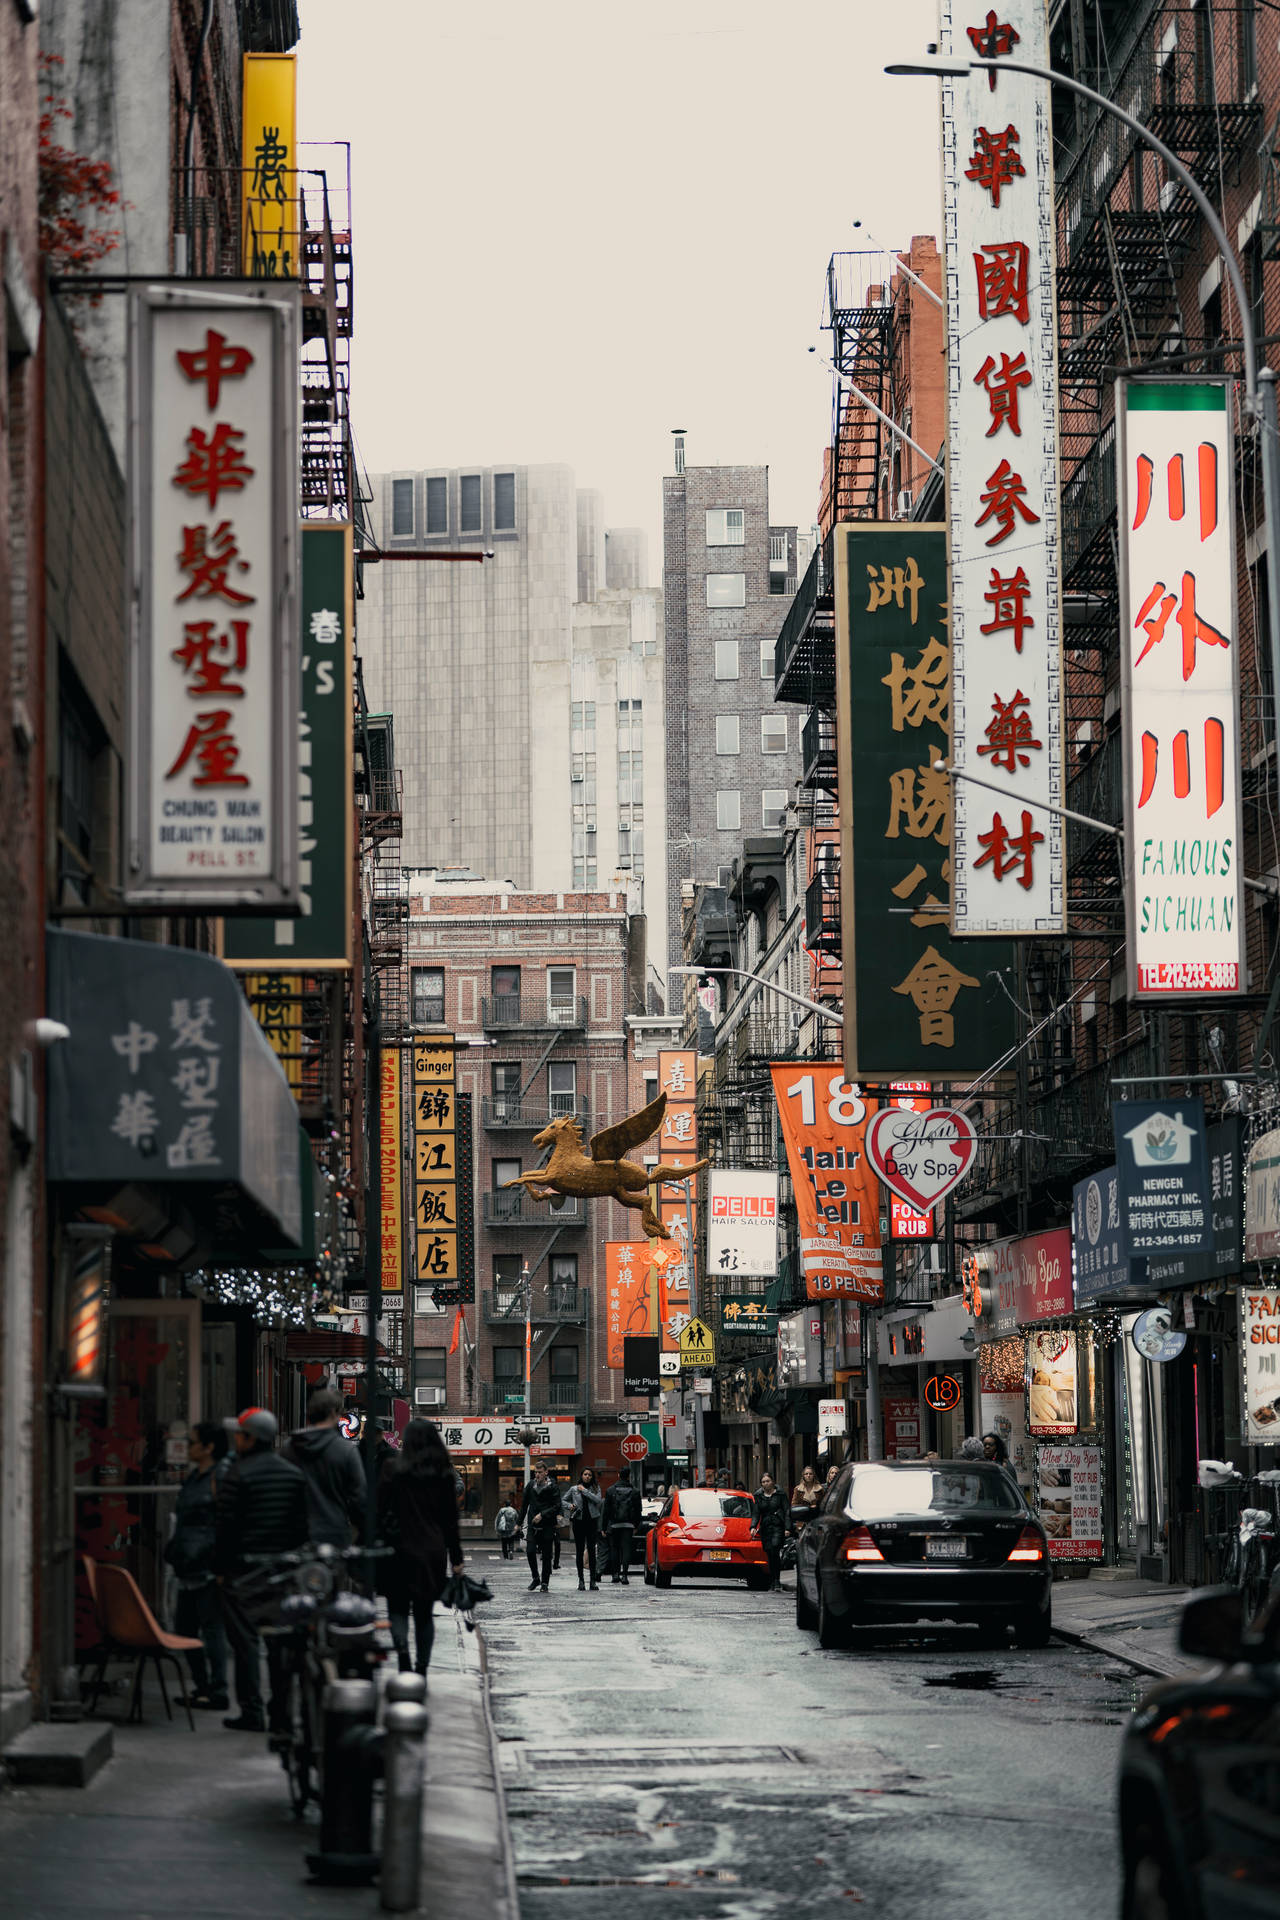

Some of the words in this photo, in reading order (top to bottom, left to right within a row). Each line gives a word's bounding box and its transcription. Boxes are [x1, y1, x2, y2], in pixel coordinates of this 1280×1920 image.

[166, 328, 256, 788] 中華髮型屋
[1132, 441, 1232, 820] 川外川
[162, 801, 217, 818] CHUNG
[226, 801, 261, 818] WAH
[159, 825, 214, 844] BEAUTY
[221, 826, 265, 844] SALON
[186, 850, 227, 867] PELL
[1141, 838, 1233, 877] FAMOUS
[1139, 895, 1235, 934] SICHUAN
[416, 1058, 453, 1075] Ginger
[786, 1074, 867, 1127] 18
[885, 1159, 918, 1180] Day
[923, 1159, 959, 1180] Spa
[417, 1087, 457, 1275] 錦江飯店
[1143, 1177, 1184, 1191] NEWGEN
[713, 1196, 775, 1217] PELL
[1127, 1195, 1181, 1208] PHARMACY
[1182, 1193, 1202, 1205] INC.
[711, 1217, 737, 1226] HAIR
[740, 1218, 776, 1226] SALON
[897, 1221, 928, 1235] RUB
[1127, 1209, 1205, 1230] 新時代西藥房
[1132, 1233, 1203, 1248] 212-349-1857
[1037, 1248, 1062, 1296] Spa
[813, 1275, 832, 1291] 18
[683, 1353, 712, 1364] AHEAD
[624, 1377, 641, 1386] Hair
[642, 1377, 659, 1386] Plus
[934, 1376, 954, 1401] 18
[1031, 1426, 1075, 1434] 212-732-2888
[622, 1442, 647, 1454] STOP
[1041, 1447, 1062, 1466] Glow
[1064, 1449, 1081, 1468] Day
[1082, 1449, 1099, 1469] Spa
[1073, 1472, 1086, 1483] FOOT
[1087, 1472, 1099, 1483] RUB
[1073, 1507, 1087, 1518] BODY
[1088, 1507, 1099, 1518] RUB
